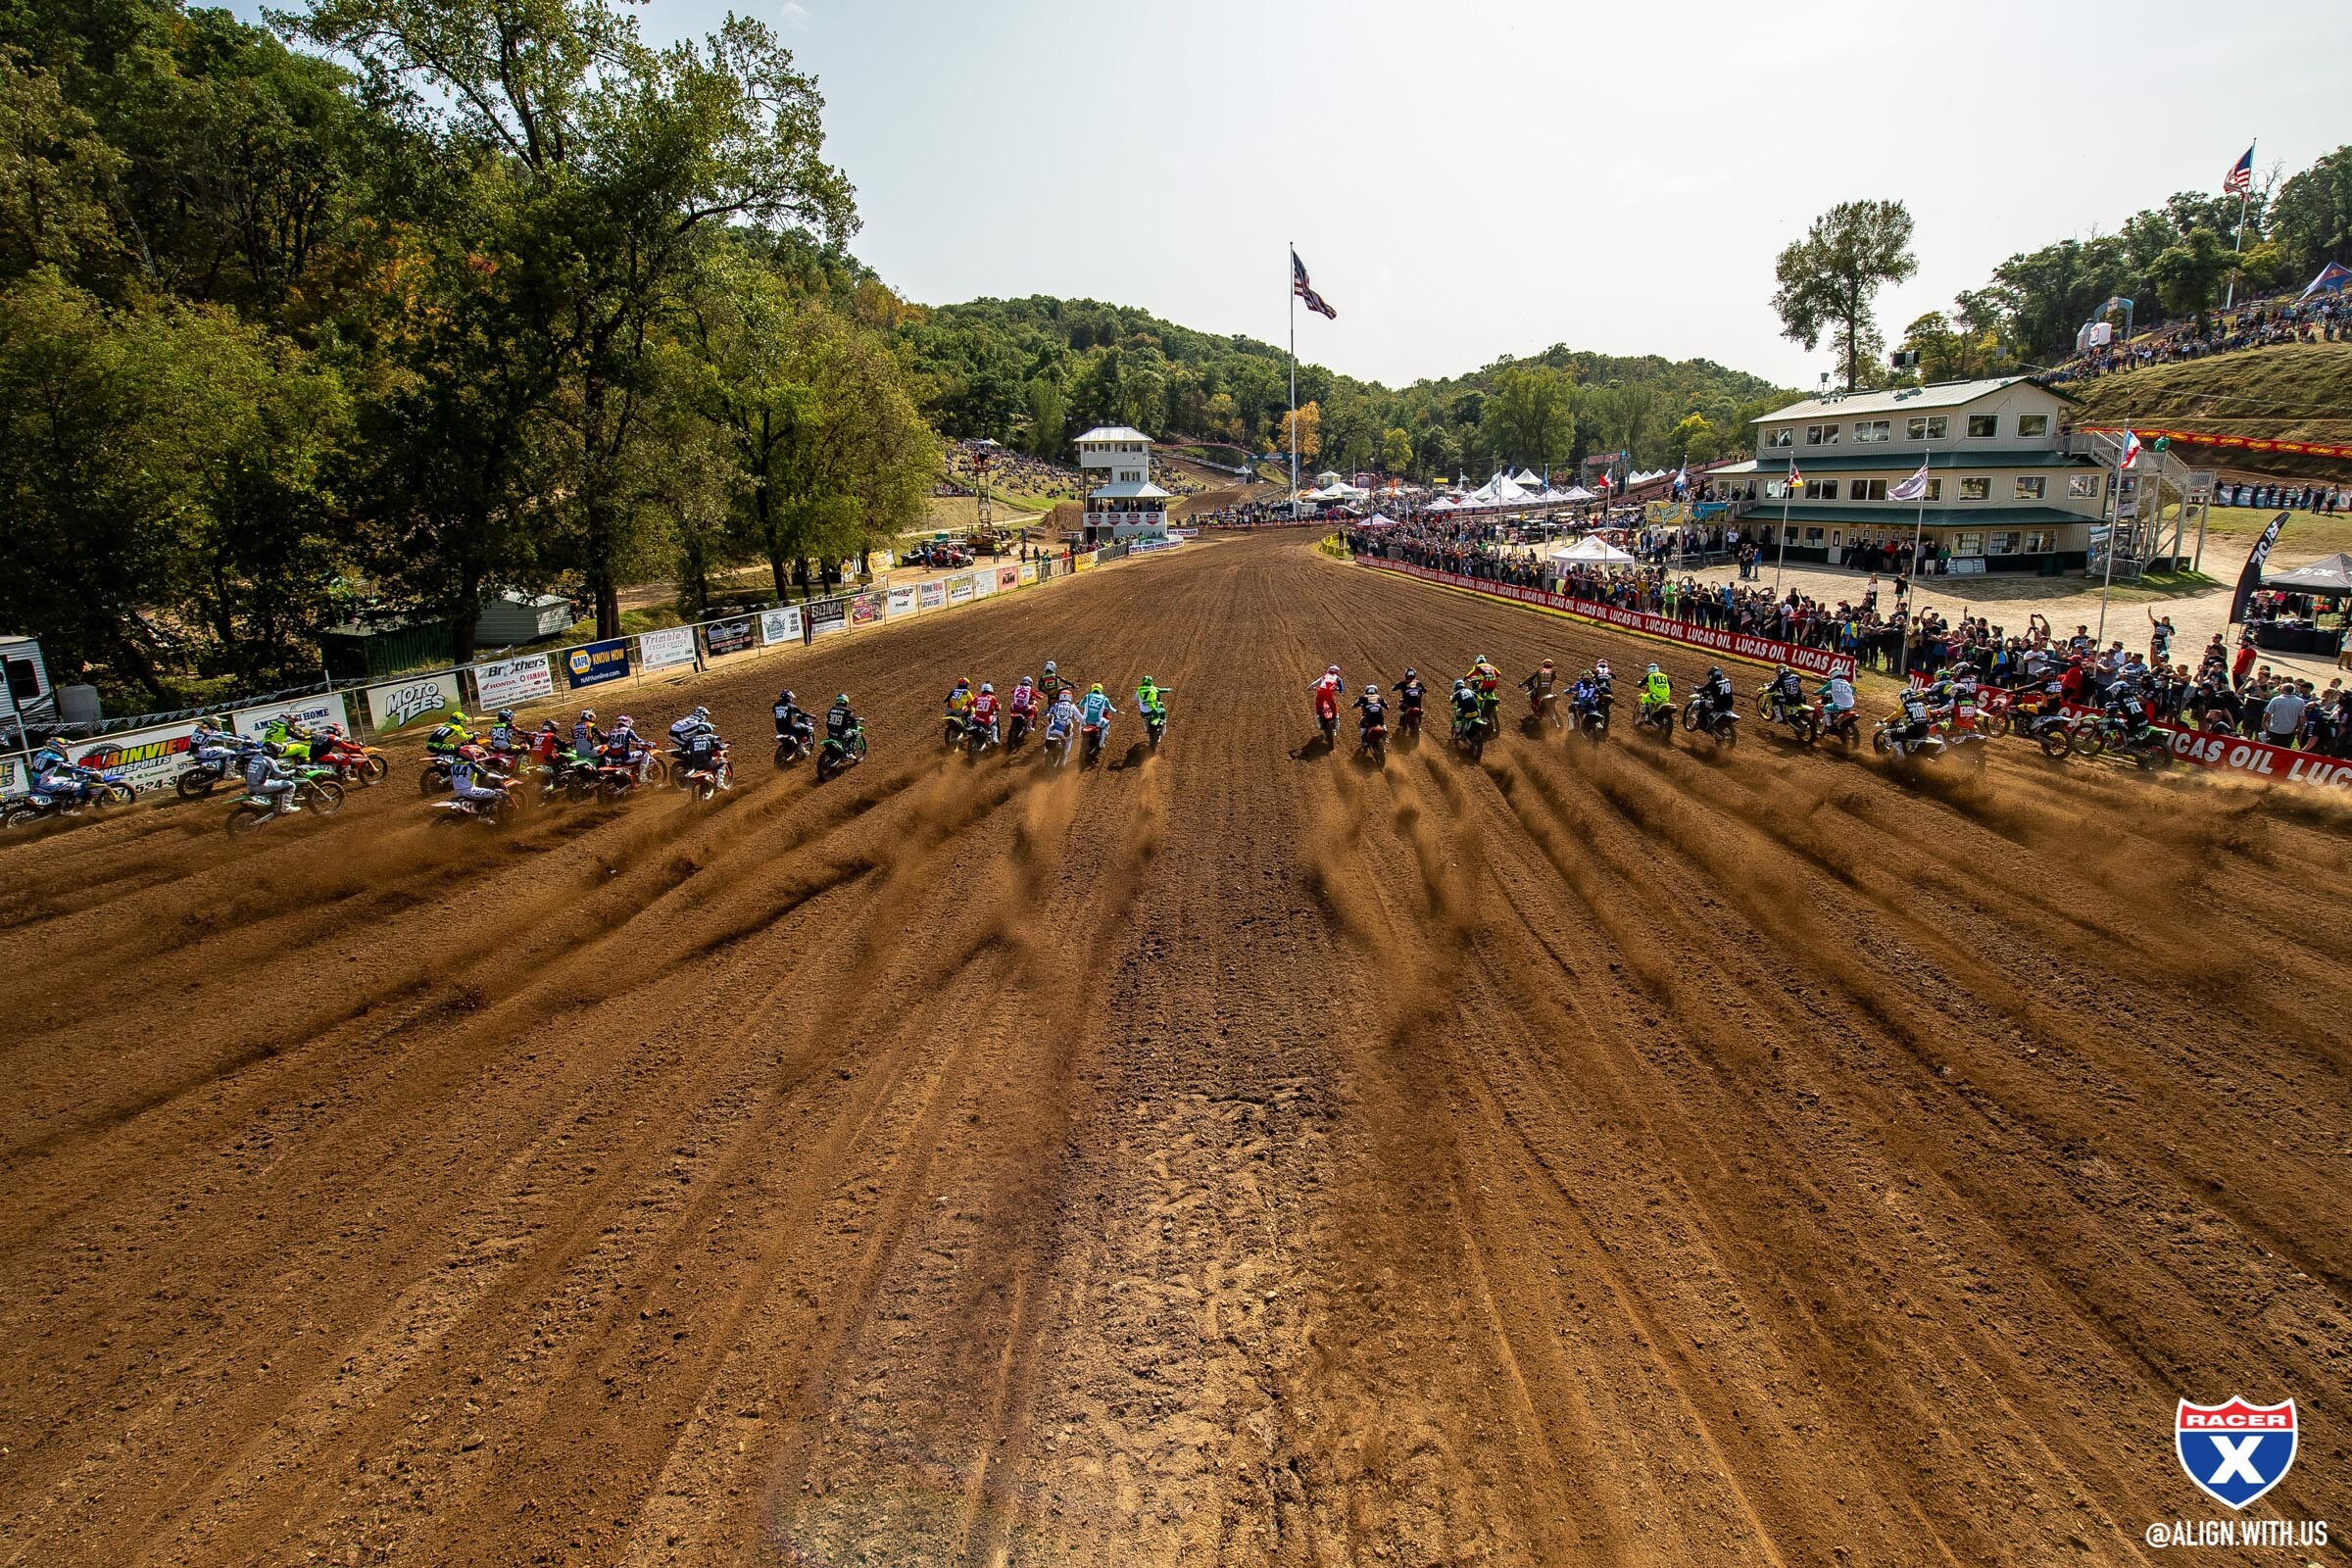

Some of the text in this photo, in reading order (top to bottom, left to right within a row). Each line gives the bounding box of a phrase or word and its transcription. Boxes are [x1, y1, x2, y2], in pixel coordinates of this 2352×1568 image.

[1002, 572, 1015, 585] KTM
[1456, 575, 1468, 587] LUCAS
[1476, 580, 1489, 591] LUCAS
[1497, 585, 1511, 597] LUCAS
[1522, 589, 1537, 602] LUCAS
[1548, 595, 1574, 610] LUCAS OIL
[1576, 602, 1607, 619] LUCAS OIL
[1609, 610, 1642, 627] LUCAS OIL
[1645, 617, 1684, 638] LUCAS OIL
[644, 629, 689, 646] Trimble's
[1687, 627, 1731, 649] LUCAS OIL
[649, 639, 687, 651] CYCLE CENTER
[1735, 637, 1787, 662] LUCAS OIL
[573, 657, 589, 668] NAPA
[592, 648, 624, 665] KNOW HOW
[1791, 649, 1829, 670] LUCAS
[525, 670, 548, 681] YAMAHA
[580, 669, 620, 684] NAPAonline.com
[1652, 675, 1667, 685] 103
[490, 679, 516, 689] HONDA
[1718, 683, 1732, 695] 78
[386, 682, 440, 716] MOTO
[952, 691, 963, 700] 31
[1015, 689, 1028, 700] 25
[976, 701, 991, 712] 20
[1089, 698, 1102, 707] 62
[2128, 701, 2143, 714] 70
[303, 707, 329, 722] HOME
[396, 693, 446, 727] TEES
[1911, 706, 1927, 718] 700
[693, 740, 707, 751] 503
[2229, 745, 2274, 775] OIL
